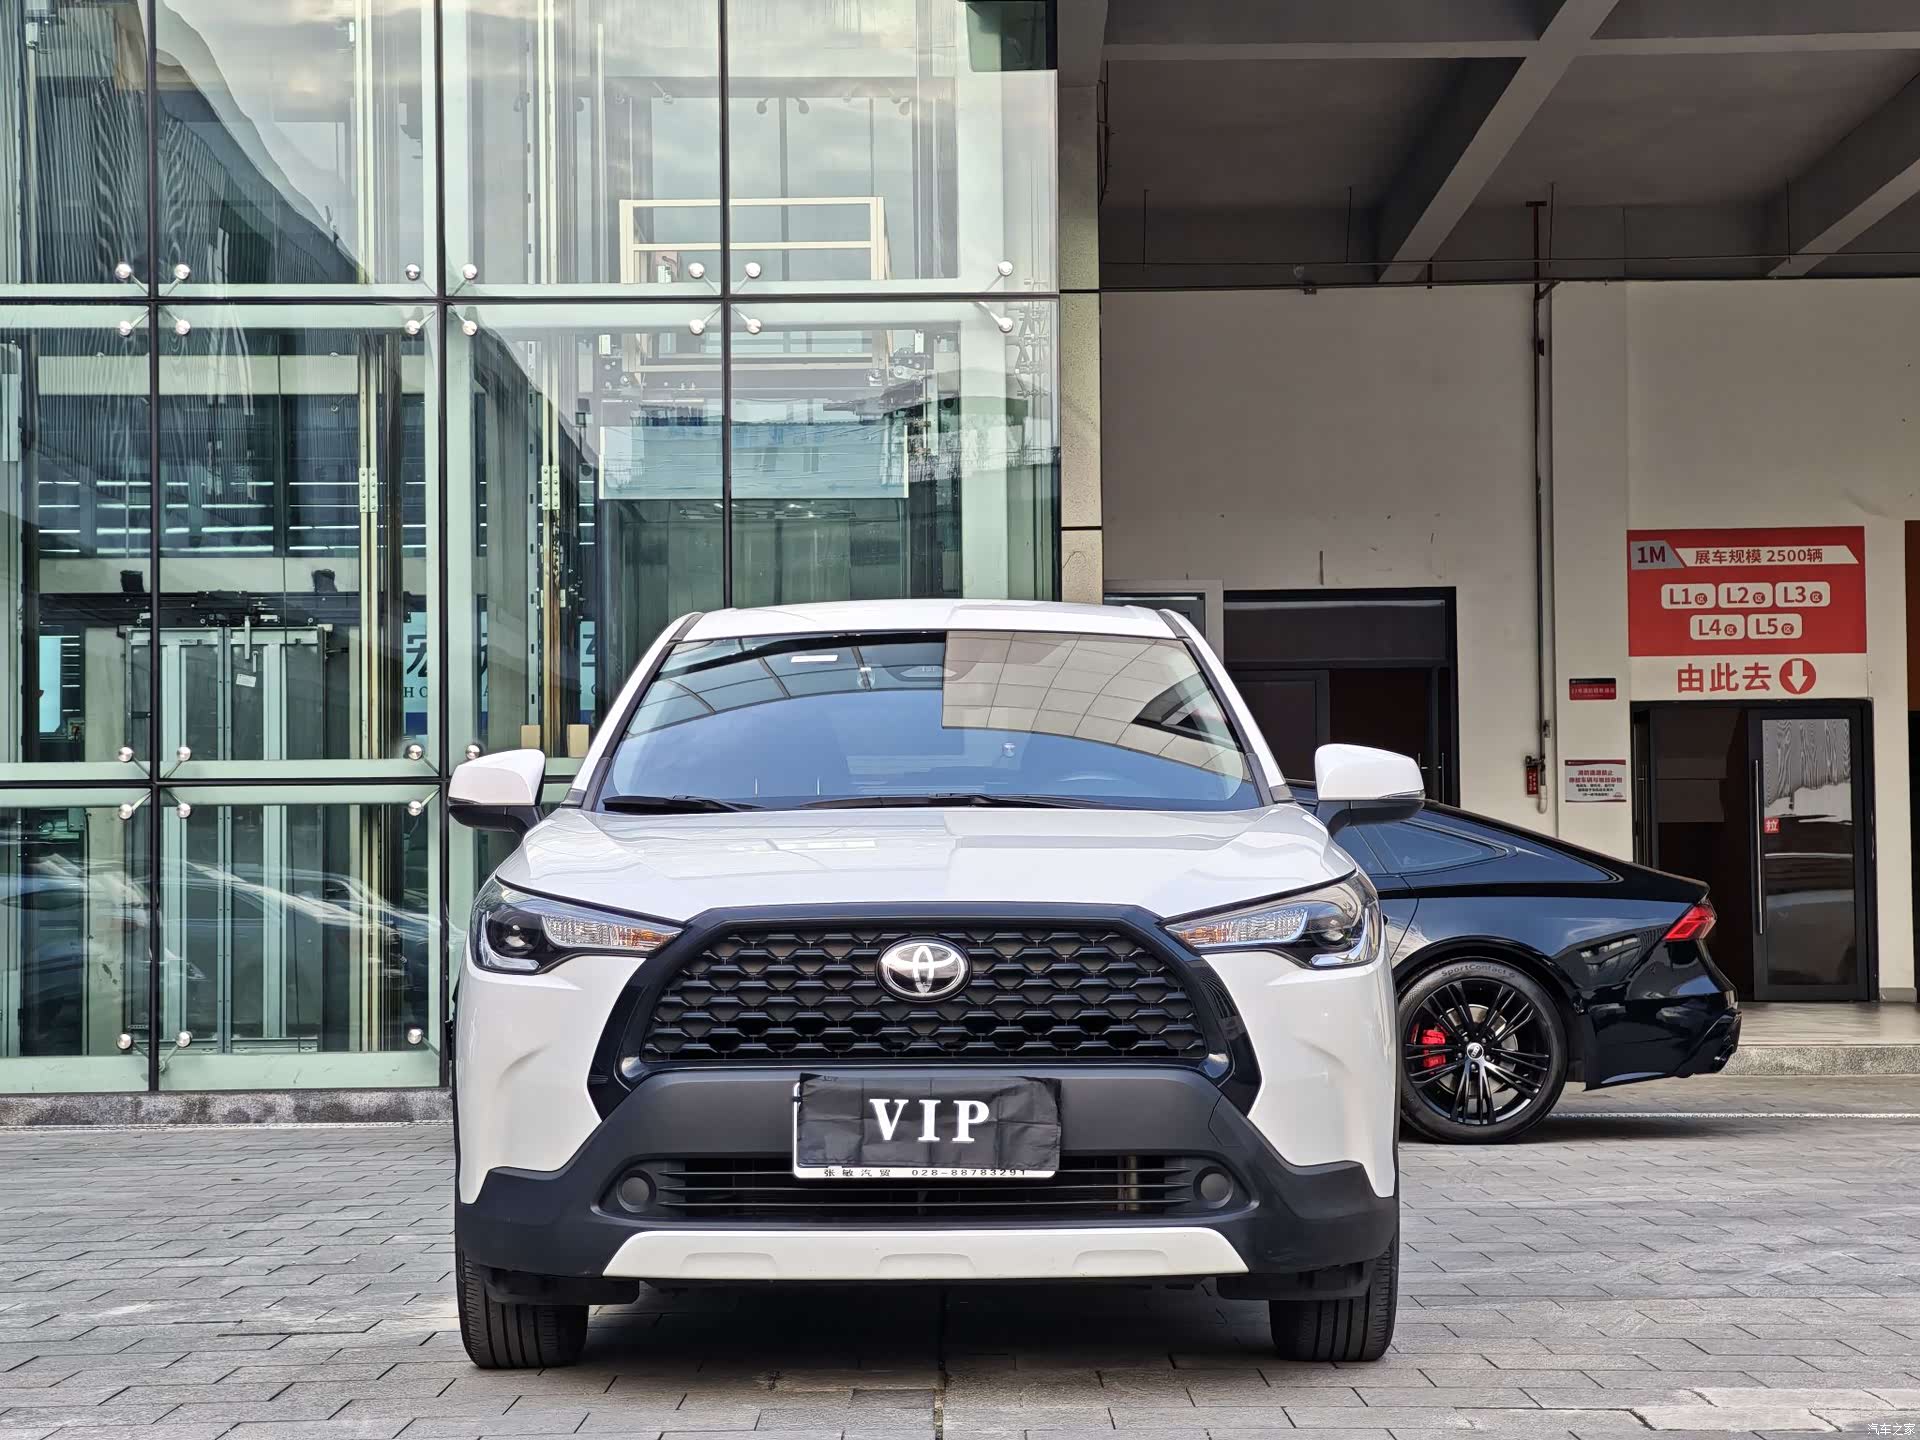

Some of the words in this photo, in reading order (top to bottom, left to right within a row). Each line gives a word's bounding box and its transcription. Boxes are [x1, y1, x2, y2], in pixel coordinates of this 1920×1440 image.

[1637, 546, 1666, 563] 1M
[1694, 549, 1762, 565] 展车规模
[1767, 548, 1824, 563] 2500辆
[1677, 662, 1772, 693] 由此去
[869, 1098, 990, 1143] VIP
[911, 1168, 1026, 1177] 028-88783291
